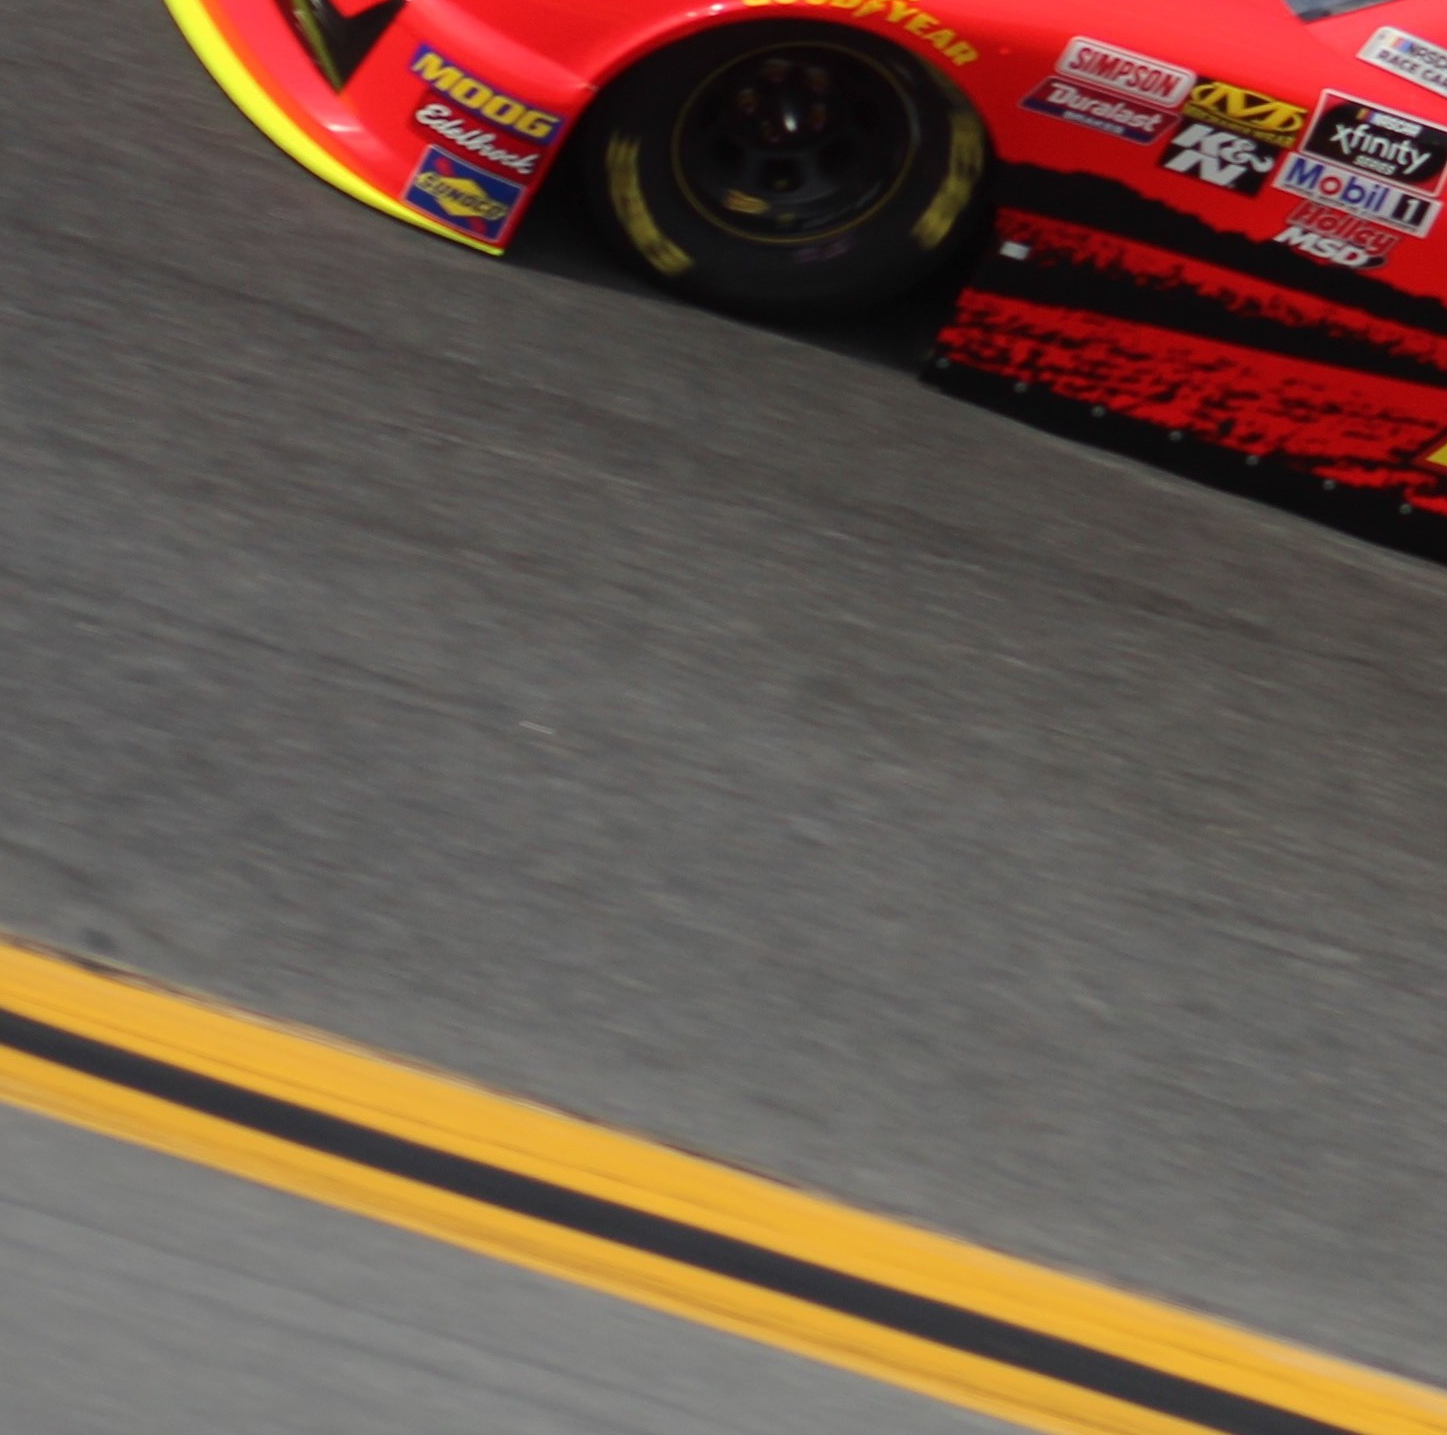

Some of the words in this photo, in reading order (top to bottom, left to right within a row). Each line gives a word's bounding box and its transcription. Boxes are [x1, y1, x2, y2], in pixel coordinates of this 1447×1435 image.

[412, 51, 560, 139] MOOG
[1070, 47, 1181, 99] SIMPSON
[1047, 82, 1162, 132] Duralast
[415, 103, 541, 174] Edelbrock
[1329, 123, 1431, 175] xfinity
[415, 172, 508, 221] SUNOCO
[1286, 158, 1391, 212] Mobil
[1405, 198, 1421, 224] 1
[1273, 226, 1370, 267] MSD
